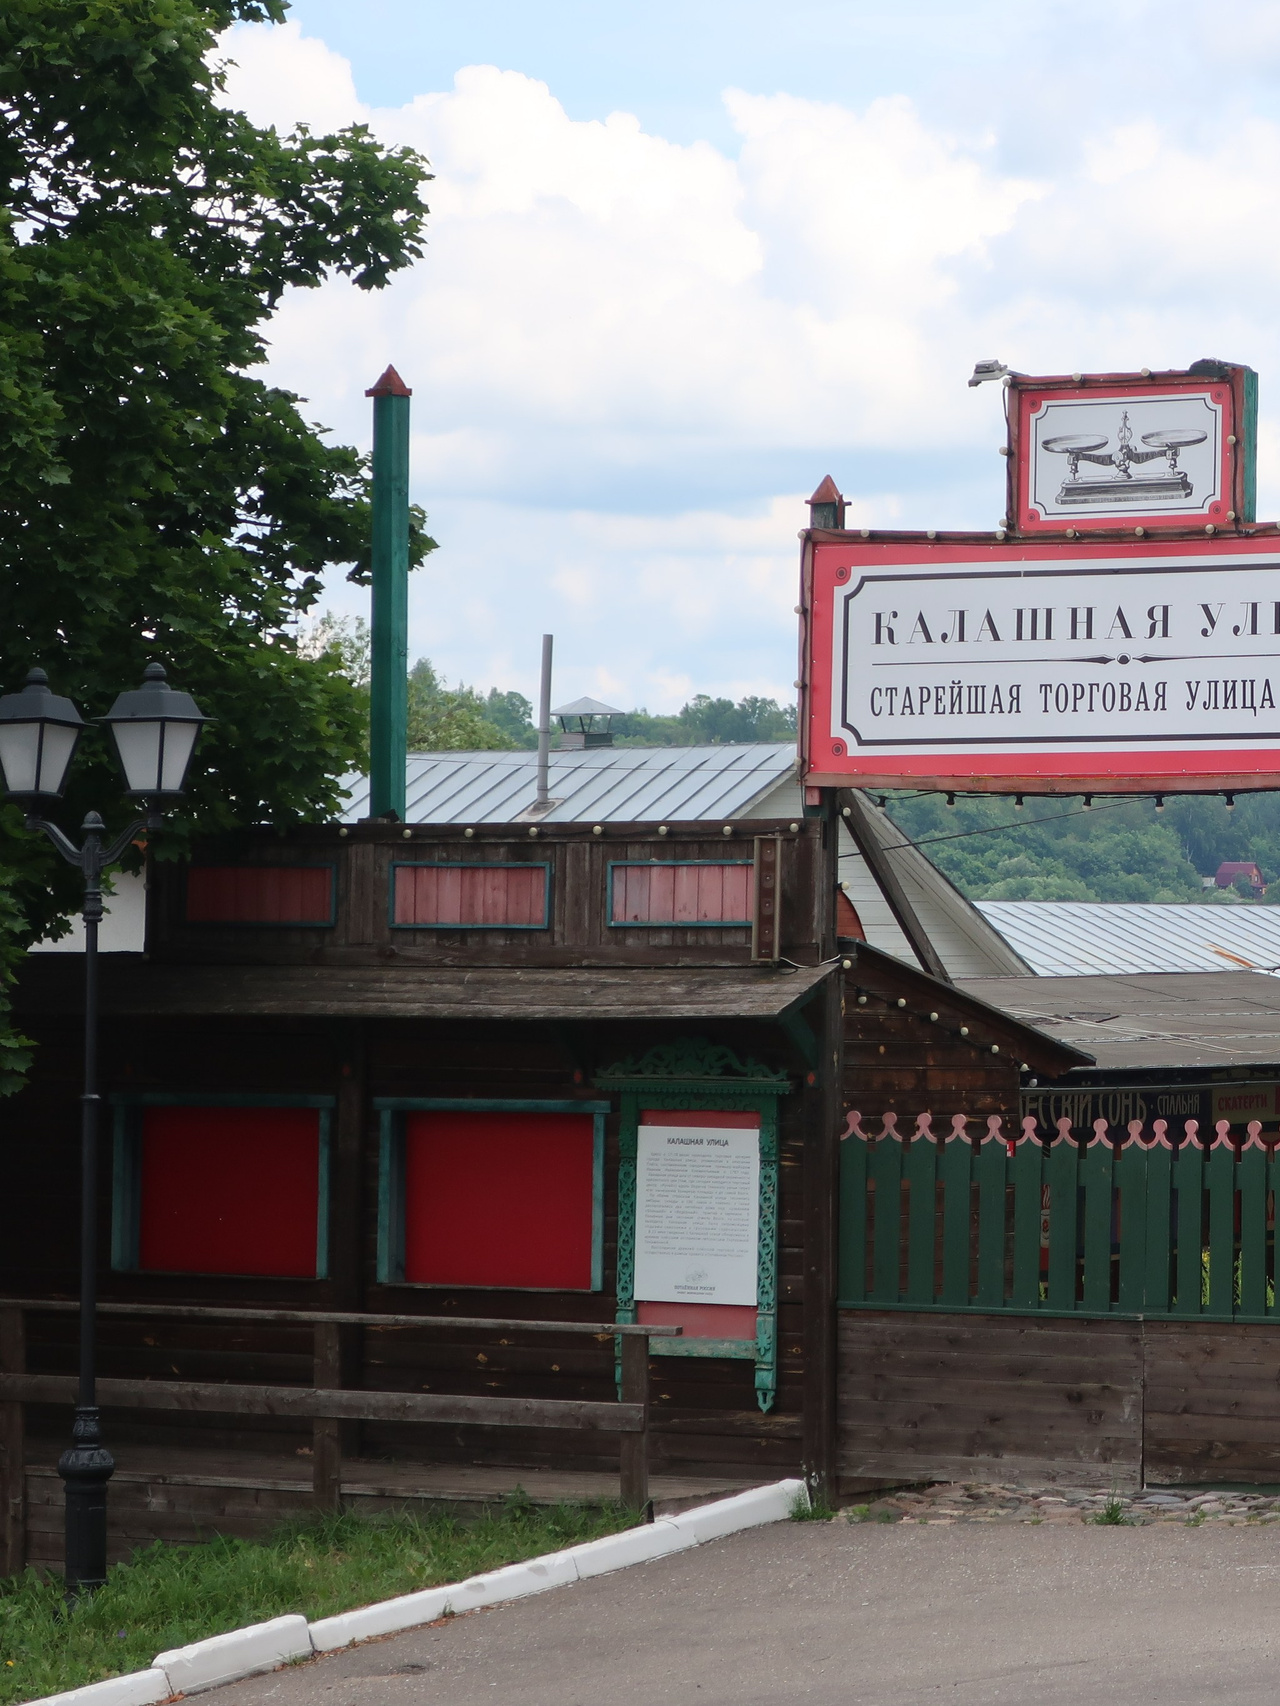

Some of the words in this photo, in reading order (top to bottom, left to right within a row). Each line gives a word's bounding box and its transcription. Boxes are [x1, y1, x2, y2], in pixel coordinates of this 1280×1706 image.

[870, 604, 1173, 645] КАЛАШНАЯ
[870, 679, 1022, 717] СТАРЕЙШАЯ
[1039, 681, 1168, 714] ТОРГОВАЯ
[1185, 678, 1276, 717] УЛИЦА
[1157, 1093, 1200, 1116] СПАЛЬНЯ
[1217, 1094, 1268, 1112] СКАТЕРТИ
[666, 1137, 704, 1147] КАЛАШНАЯ
[706, 1138, 729, 1147] УЛИЦА
